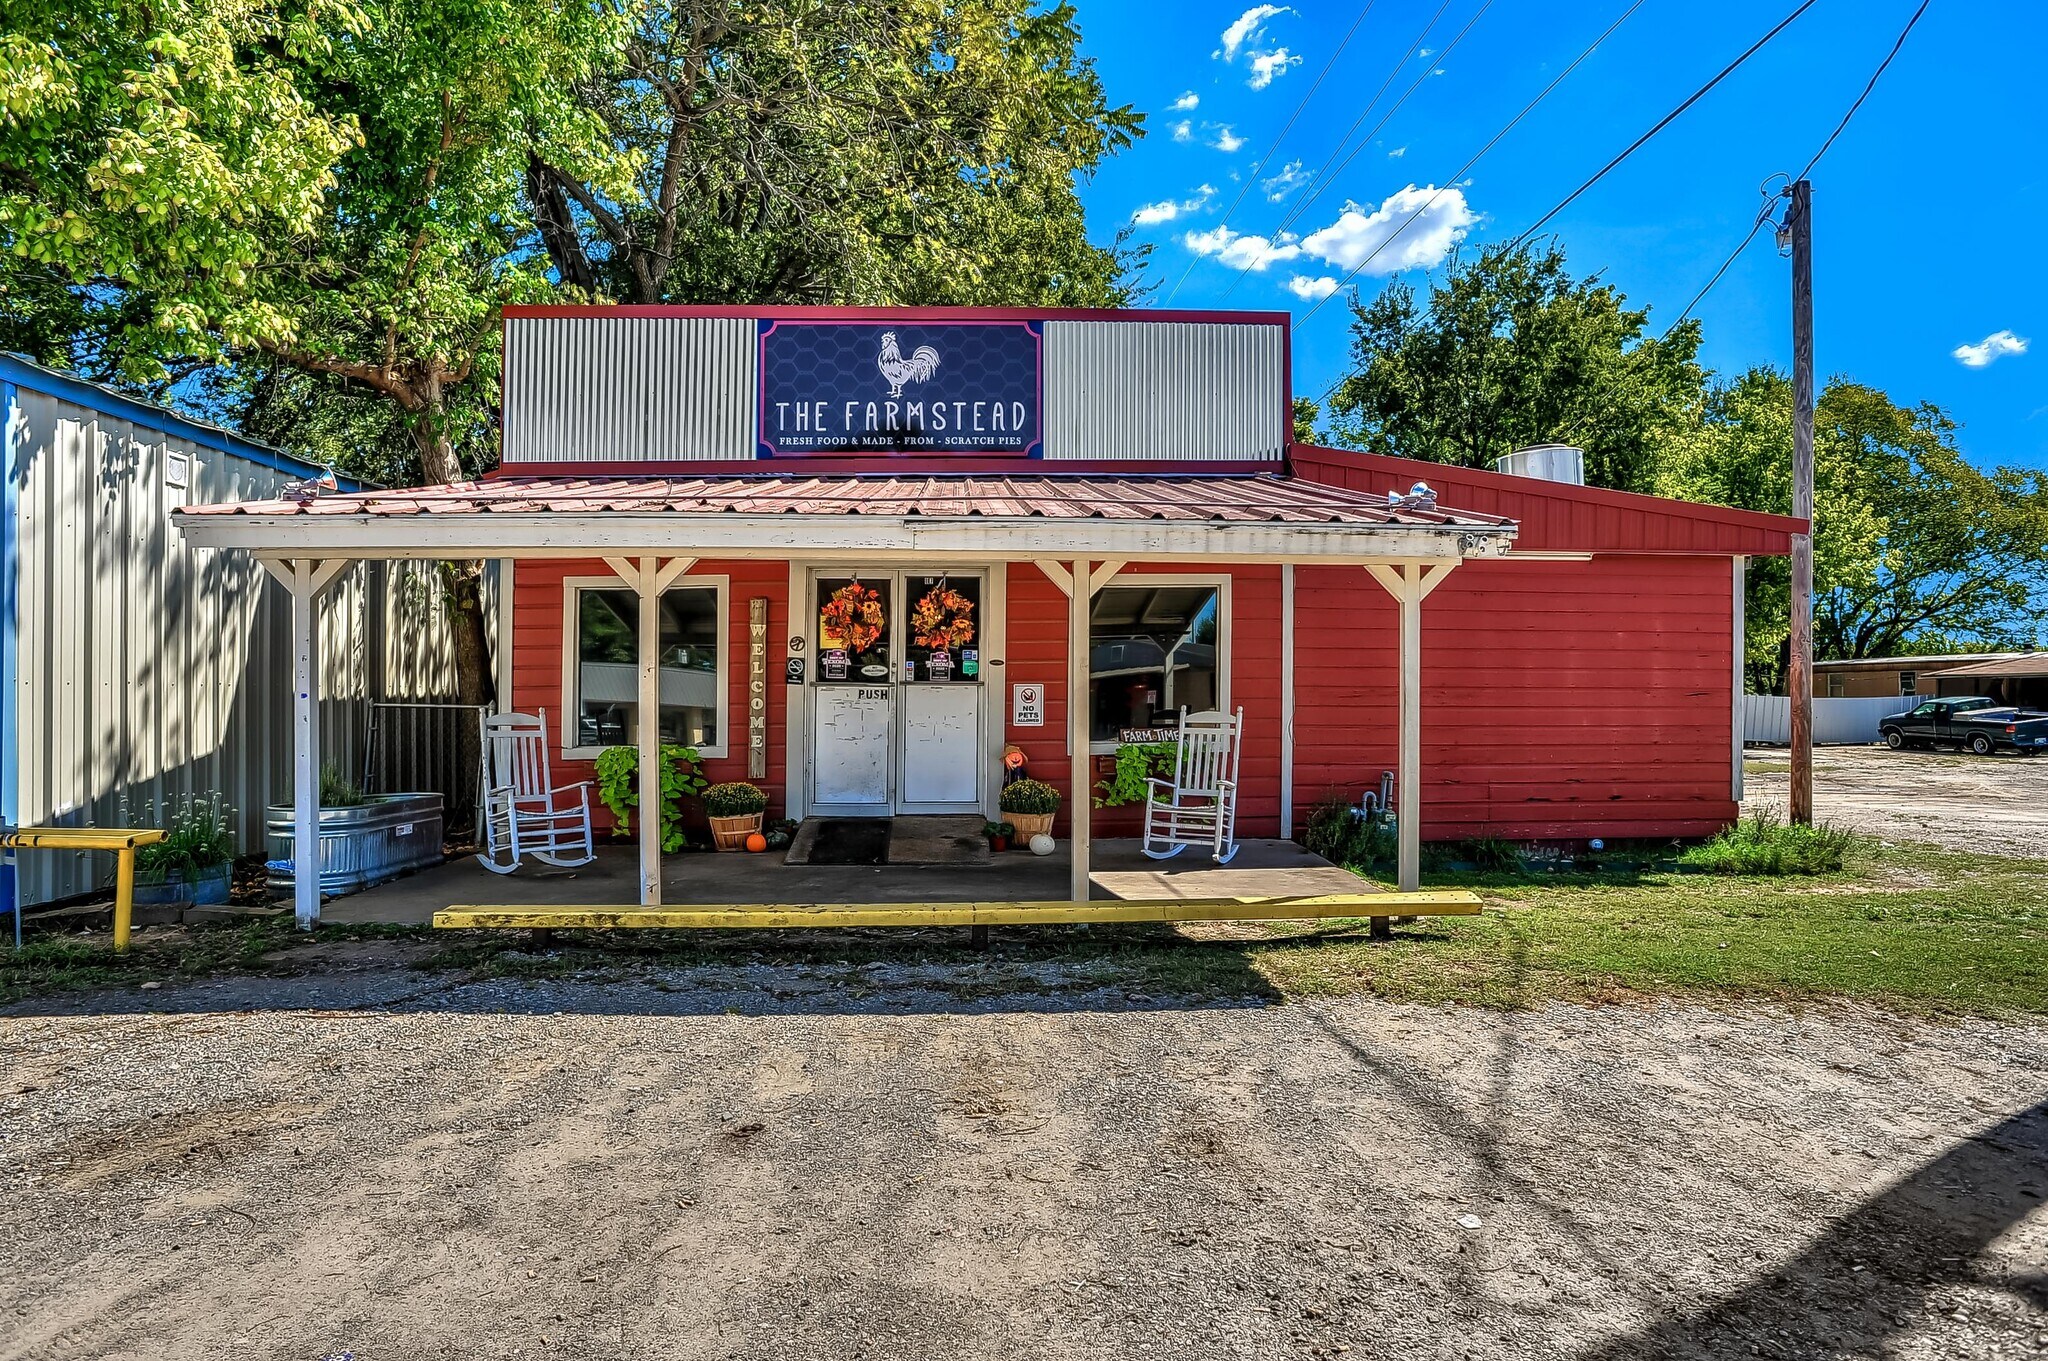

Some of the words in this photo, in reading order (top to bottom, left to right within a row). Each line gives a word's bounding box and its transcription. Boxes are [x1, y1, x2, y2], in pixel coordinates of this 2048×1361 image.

[775, 401, 828, 432] THE
[845, 401, 1026, 432] FARMSTEAD
[779, 436, 813, 446] FRESH
[817, 436, 848, 446] FOOD
[851, 436, 859, 446] &
[862, 436, 894, 446] MADE
[904, 436, 934, 445] FROM
[944, 436, 995, 445] SCRATCH
[998, 436, 1022, 445] PIES
[750, 624, 767, 748] WELCOME
[858, 689, 888, 700] PUSH
[1018, 711, 1039, 719] PETS
[1123, 728, 1152, 742] FARM
[1153, 729, 1180, 742] TIME
